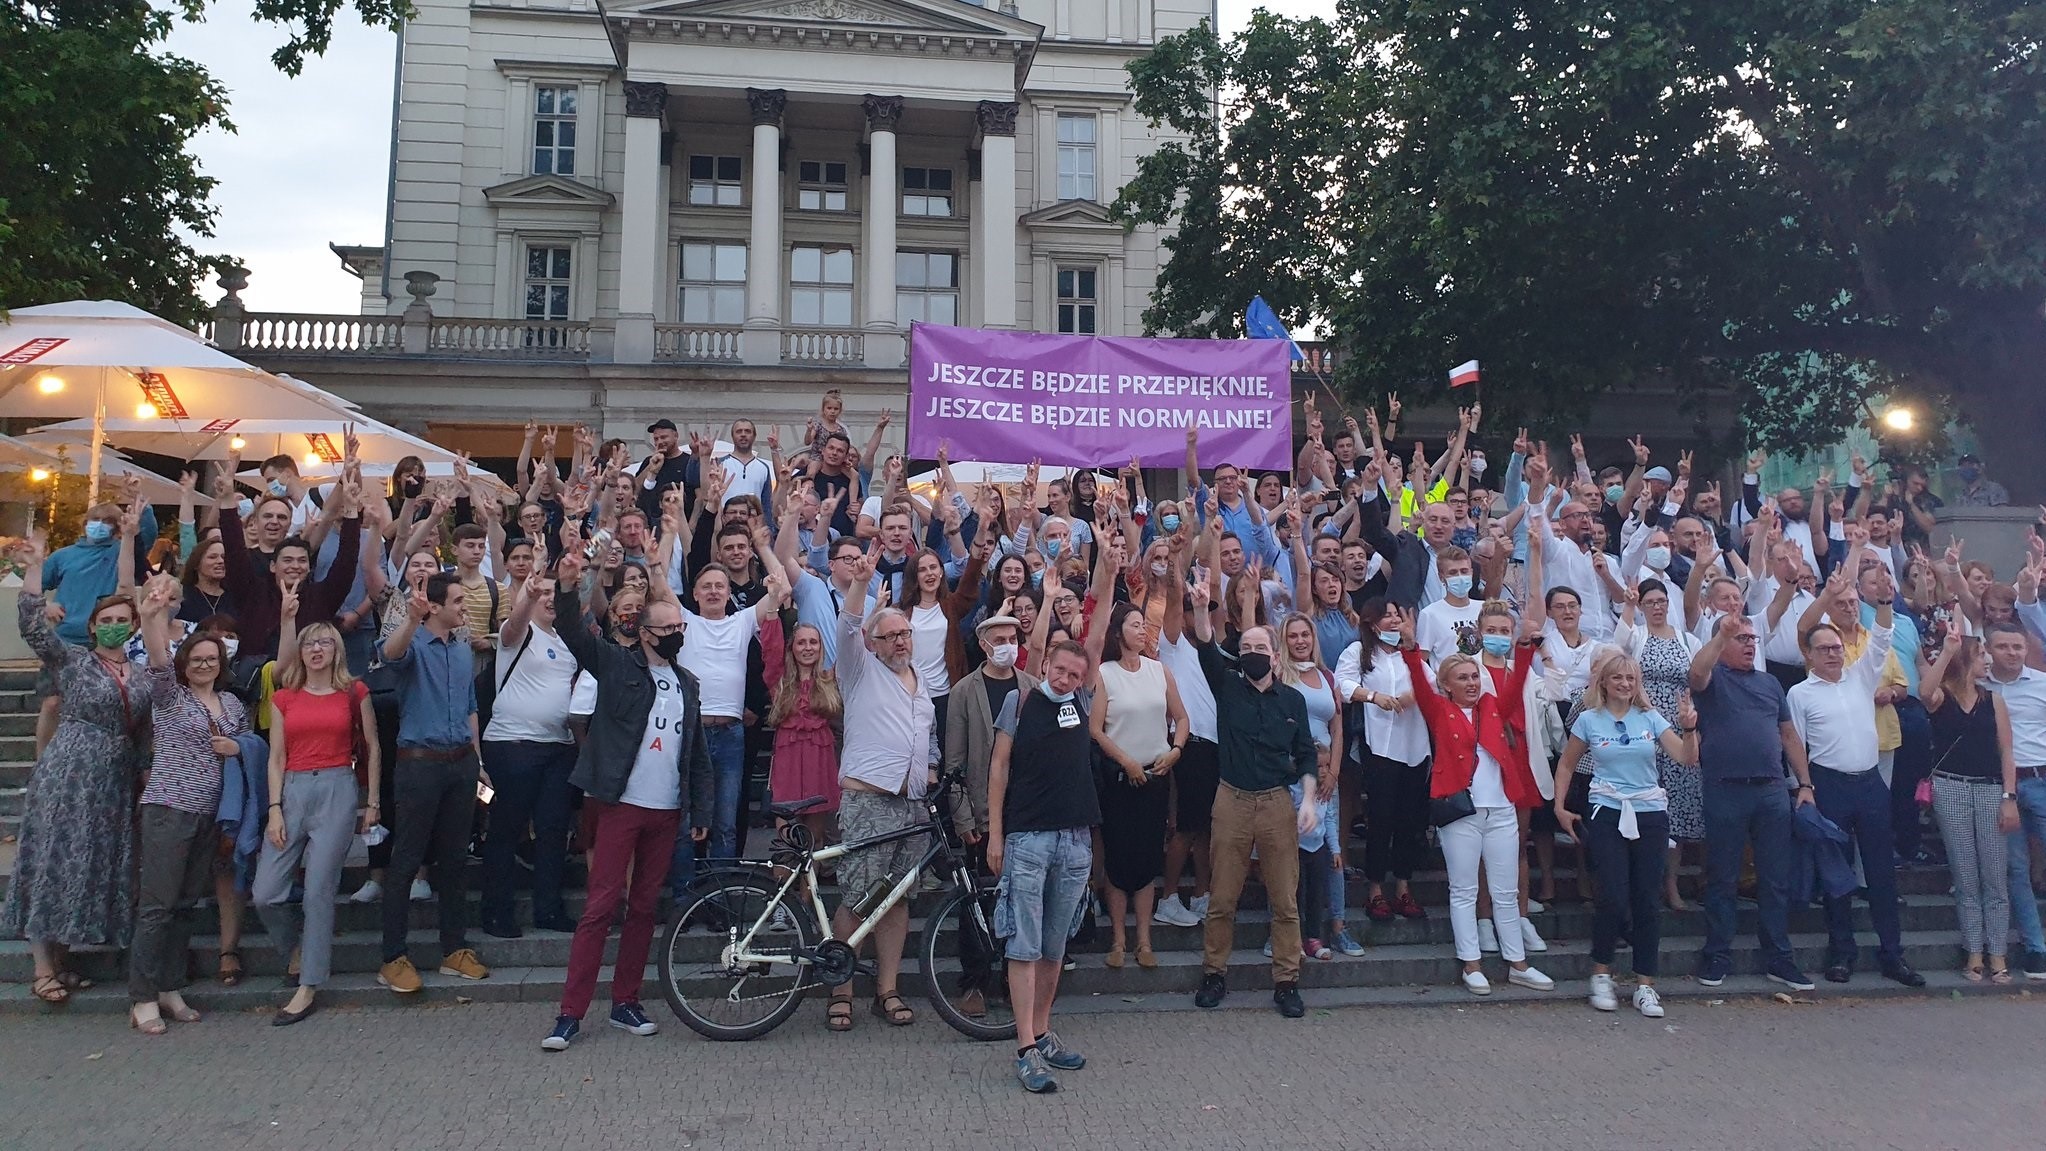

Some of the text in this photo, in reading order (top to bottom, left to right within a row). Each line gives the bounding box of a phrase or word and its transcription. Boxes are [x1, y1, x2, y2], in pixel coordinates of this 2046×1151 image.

[927, 362, 1274, 400] JESZCZE BĘDZIE PRZEPIĘKNIE,
[926, 397, 1272, 430] JESZCZE BĘDZIE NORMALNIE!
